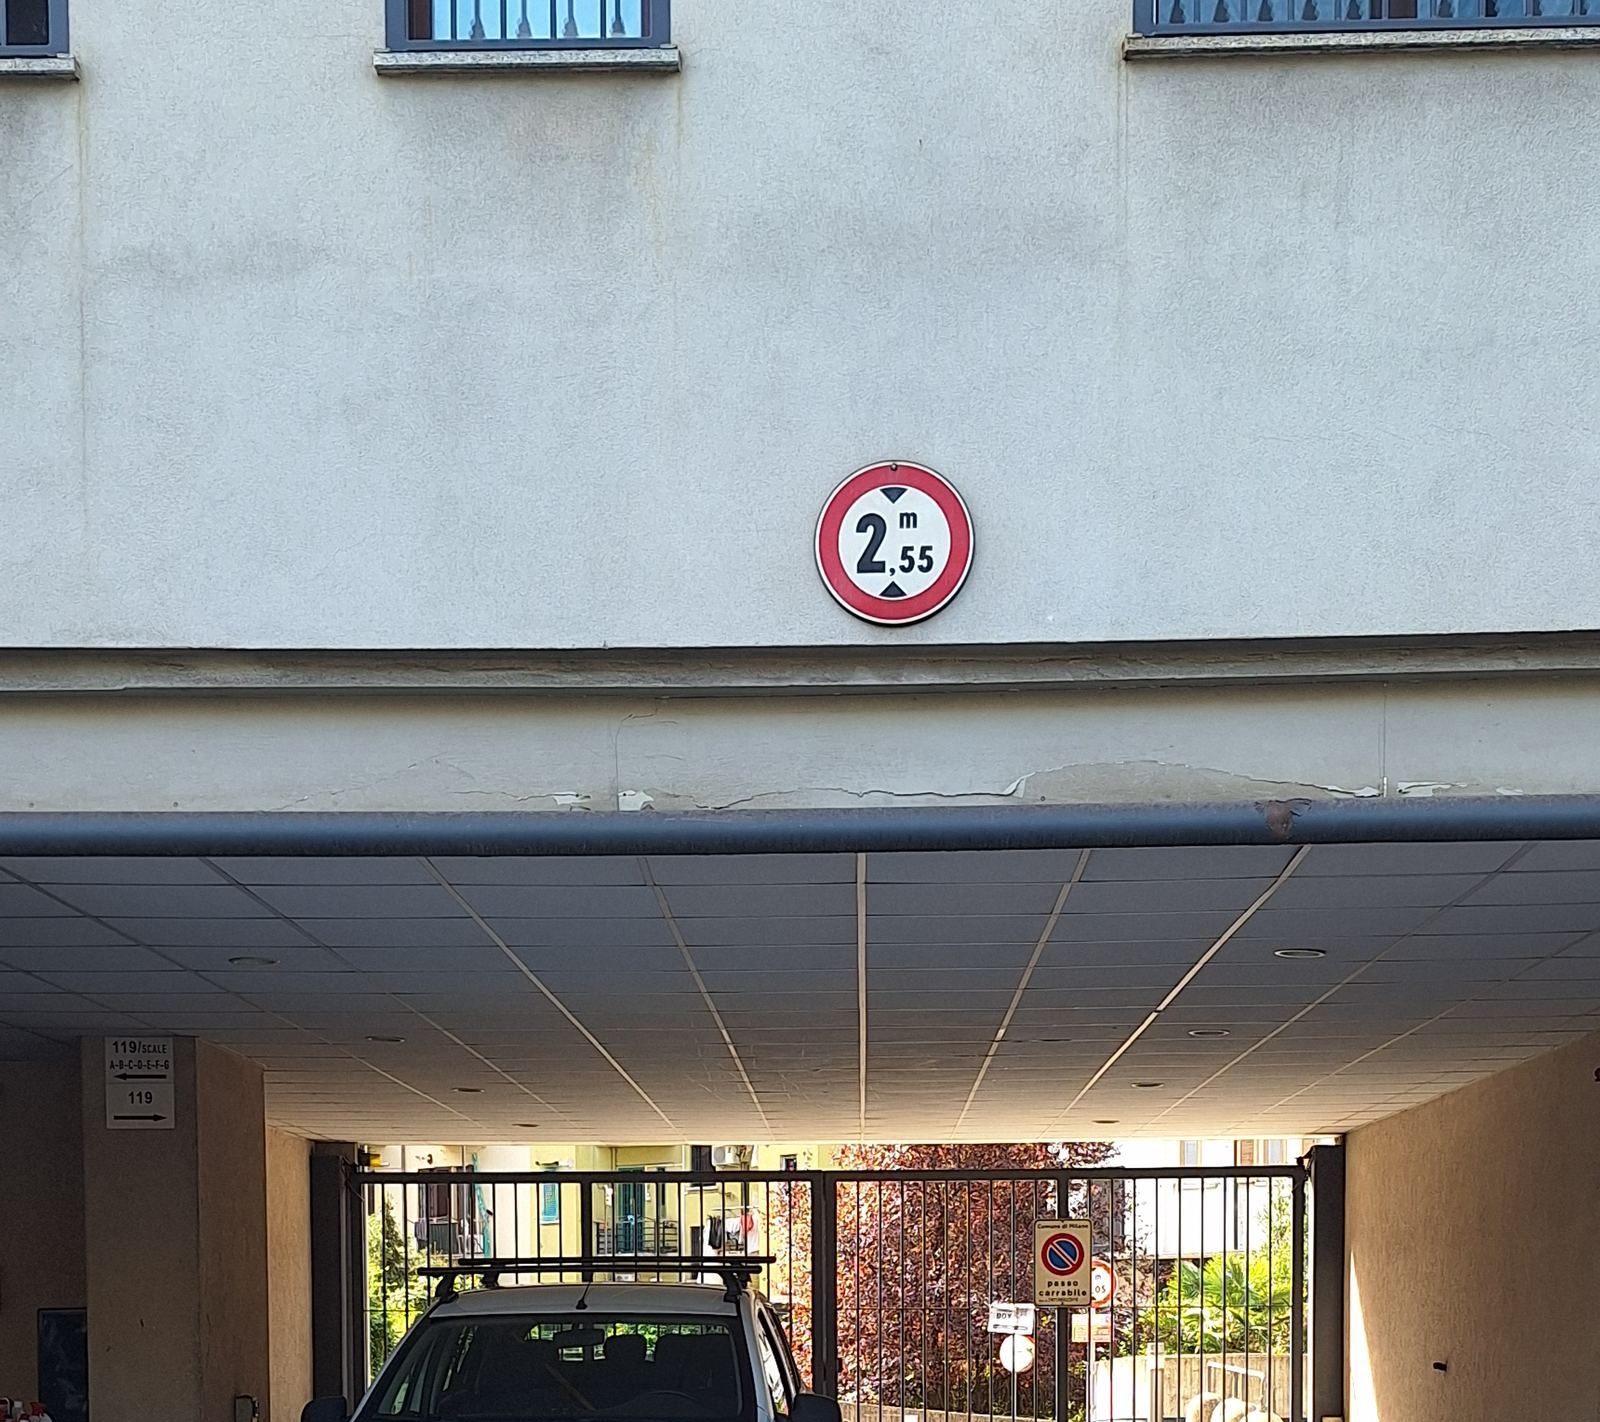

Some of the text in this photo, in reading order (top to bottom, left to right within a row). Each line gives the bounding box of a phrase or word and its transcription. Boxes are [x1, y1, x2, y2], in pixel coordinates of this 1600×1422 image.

[899, 512, 918, 529] m
[112, 1040, 168, 1054] 119/SCALE
[128, 1091, 153, 1105] 119
[1038, 1289, 1087, 1297] carrabile
